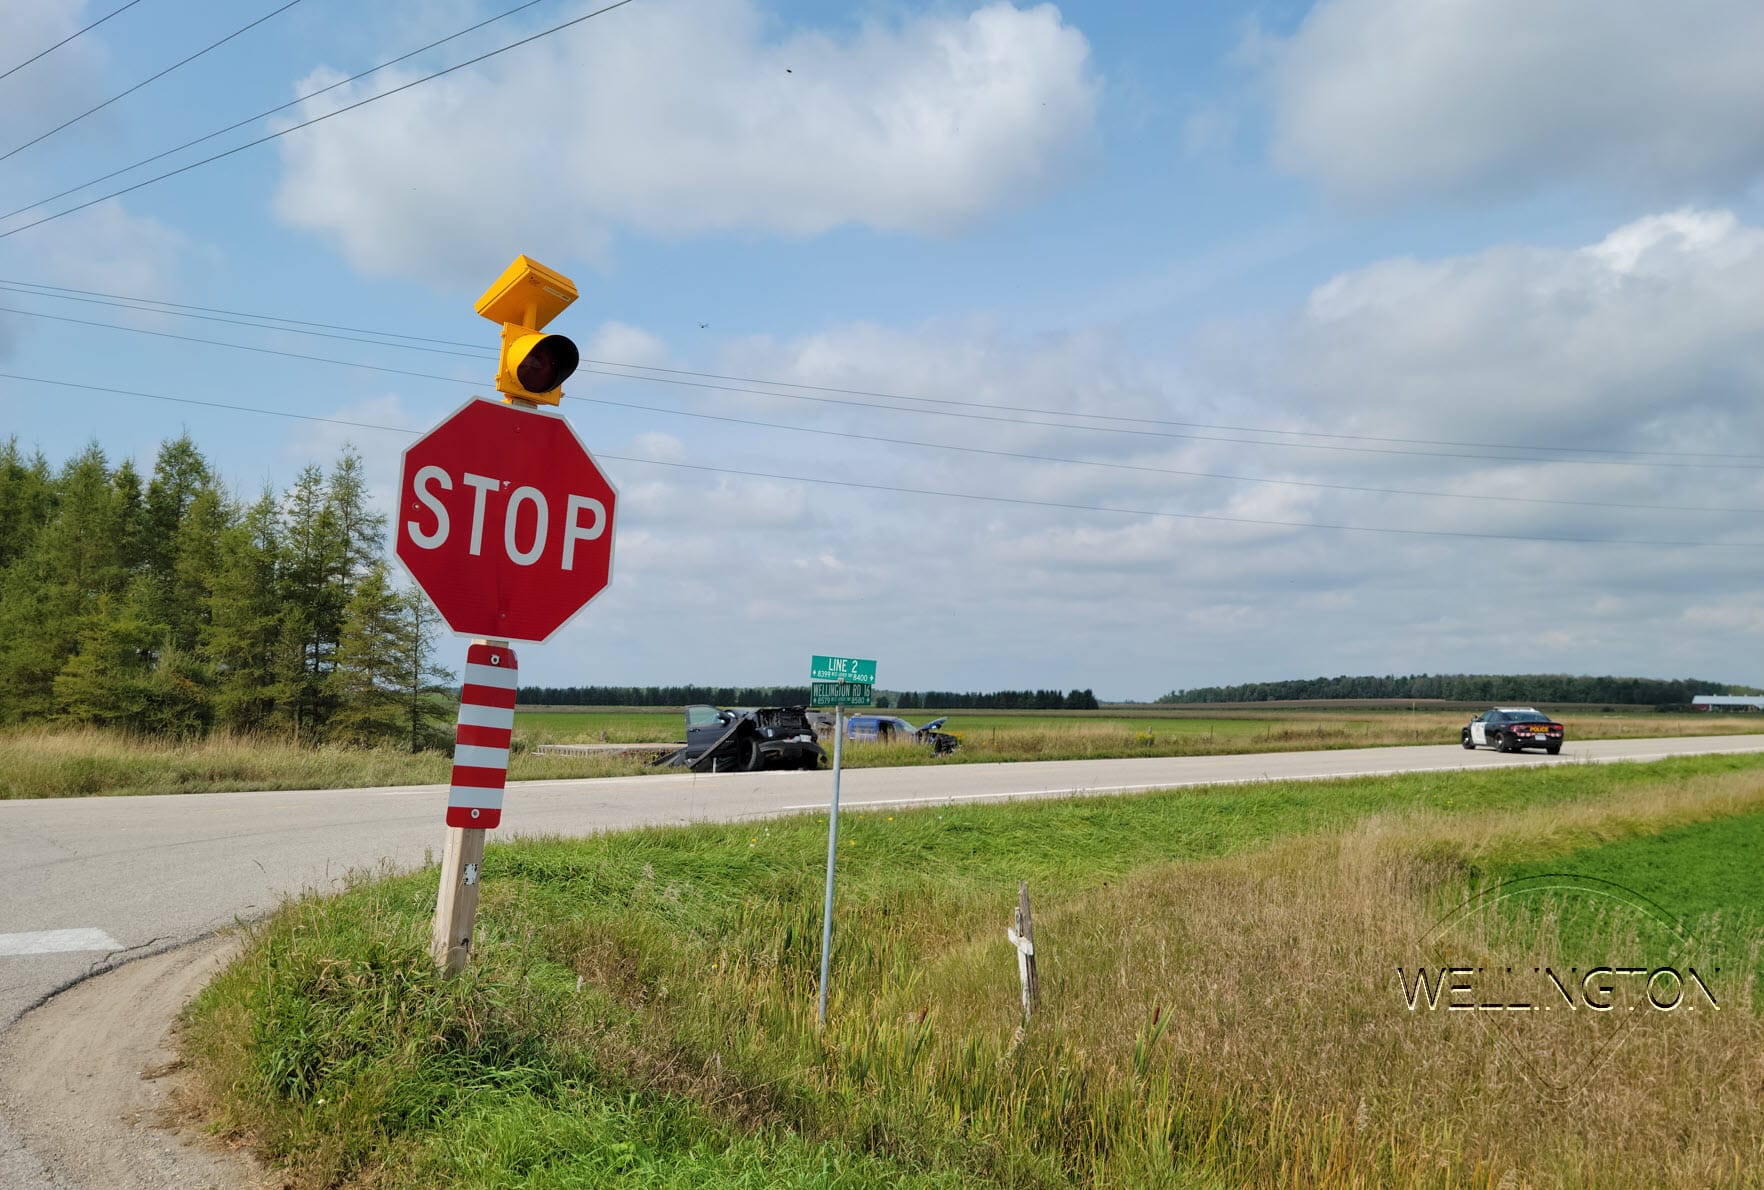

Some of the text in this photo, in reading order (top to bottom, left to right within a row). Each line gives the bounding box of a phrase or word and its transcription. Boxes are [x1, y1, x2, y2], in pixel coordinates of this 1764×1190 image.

[408, 465, 606, 571] STOP
[829, 658, 857, 673] LINE 2
[813, 684, 850, 696] WELLINGTON
[853, 685, 861, 696] RD
